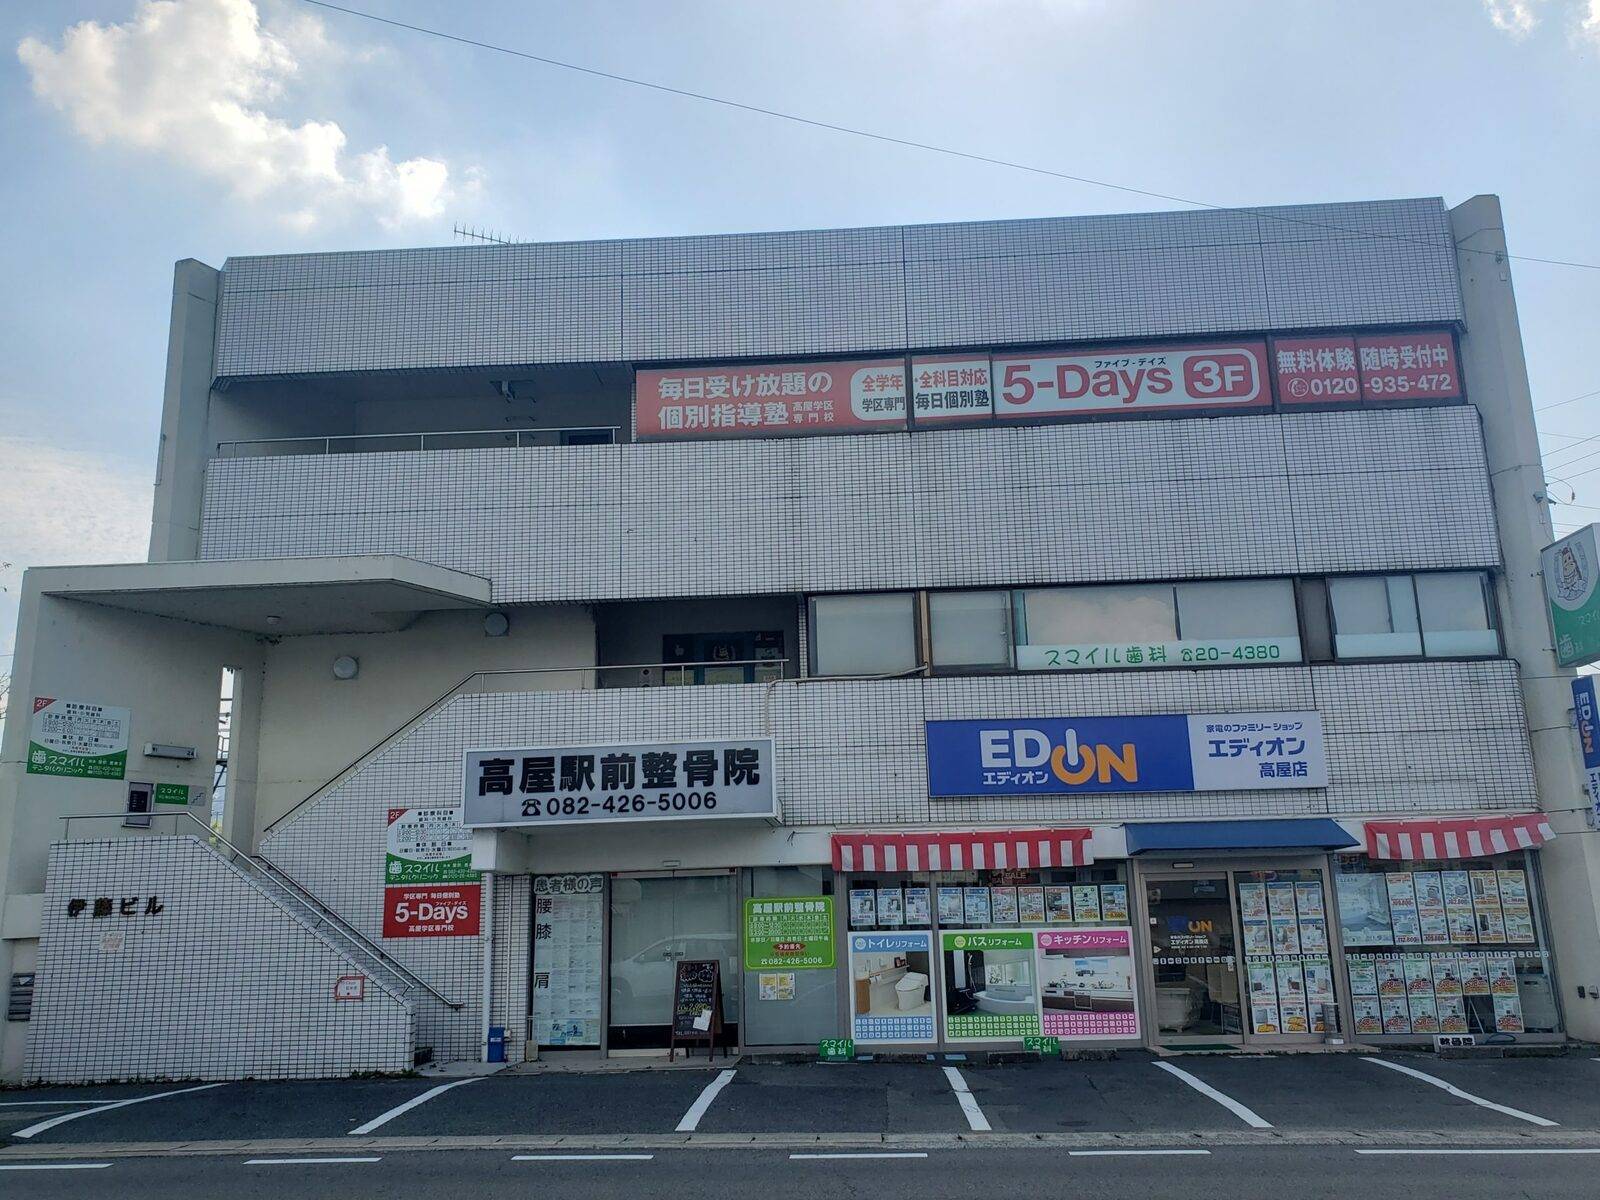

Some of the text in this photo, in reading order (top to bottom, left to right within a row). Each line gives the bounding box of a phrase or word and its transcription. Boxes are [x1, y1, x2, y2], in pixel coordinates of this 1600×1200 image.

[1277, 344, 1449, 374] 無料体験 随時受付中
[657, 371, 833, 401] 毎日受け放題の
[862, 374, 903, 393] 全学年
[1002, 360, 1247, 404] 5-Days 3F
[862, 389, 990, 412] 学区専門 毎日個別塾
[657, 402, 789, 430] 個別指導塾
[1047, 645, 1167, 666] スマイル歯科
[1208, 737, 1306, 758] エディオン
[478, 748, 760, 796] 高屋駅前整骨院
[983, 770, 1049, 786] エディオン
[1259, 761, 1308, 778] 高屋店
[546, 791, 718, 816] 082-426-5006
[395, 902, 469, 924] 5-Days
[536, 898, 553, 914] 腰
[535, 923, 553, 940] 膝
[1053, 935, 1127, 946] キッチンリフォーム
[868, 938, 928, 949] トイレリフォーム
[968, 936, 1022, 948] バスリフォーム
[534, 972, 550, 989] 肩
[821, 1039, 852, 1048] スマイル
